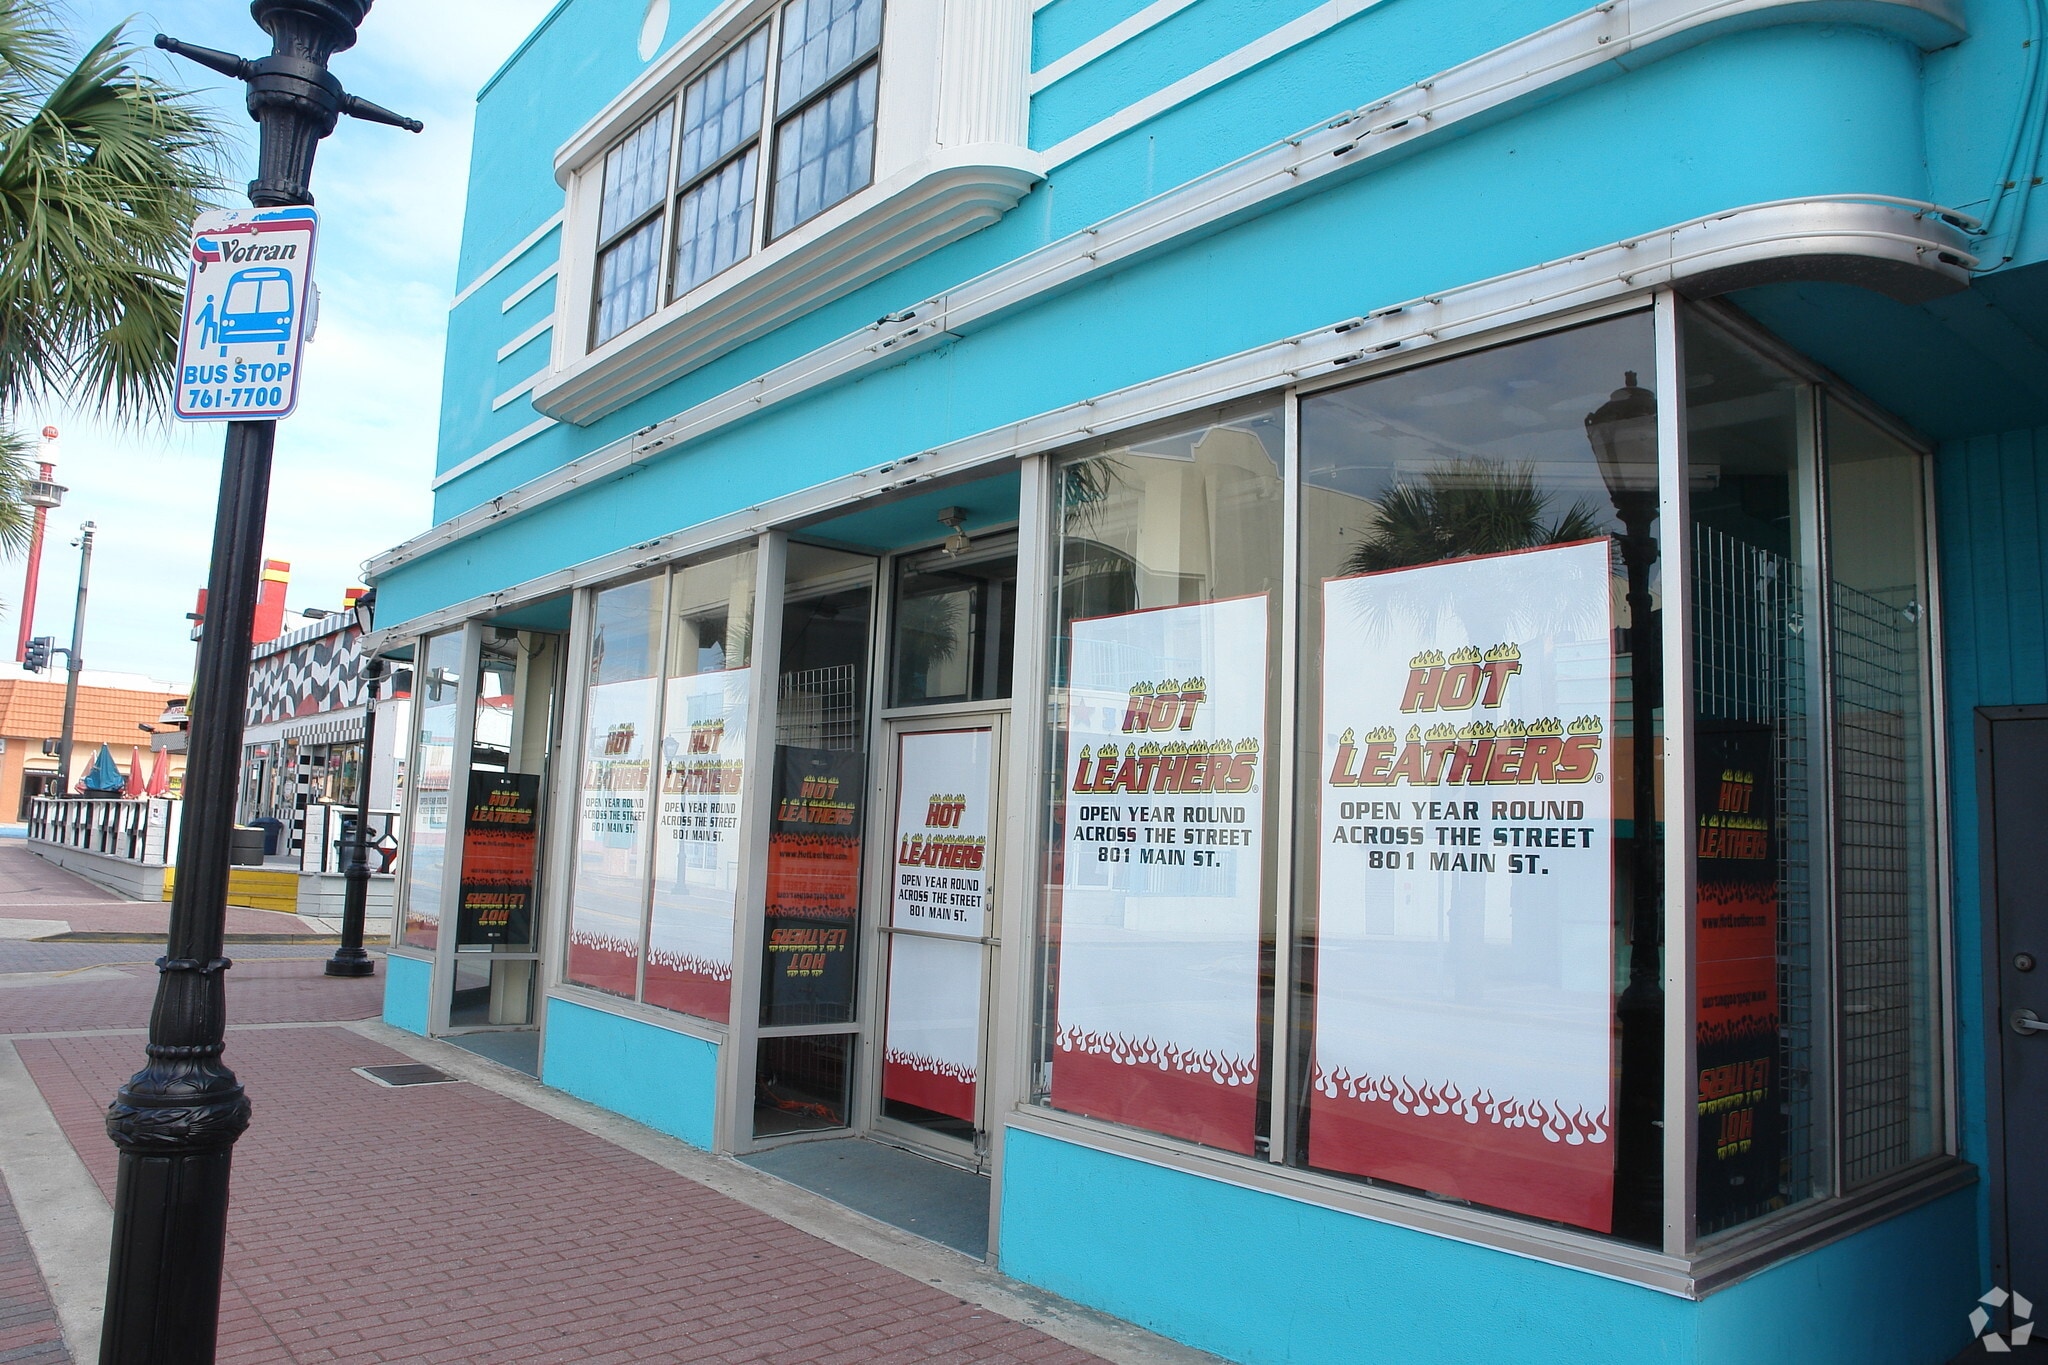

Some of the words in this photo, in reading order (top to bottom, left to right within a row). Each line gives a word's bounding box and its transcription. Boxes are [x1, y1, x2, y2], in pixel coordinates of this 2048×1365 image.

[222, 239, 297, 263] Votran
[184, 364, 228, 384] BUS
[234, 362, 292, 383] STOP
[189, 387, 282, 408] 761-7700
[1400, 660, 1522, 713] HOT
[1122, 692, 1207, 733] HOT
[605, 729, 635, 755] HOT
[687, 728, 724, 755] HOT
[584, 766, 649, 791] LEATHERS
[662, 767, 743, 795] LEATHERS
[1072, 754, 1258, 794] LEATHERS
[489, 794, 519, 807] HOT
[801, 782, 839, 800] HOT
[1719, 781, 1752, 813] HOT
[586, 798, 601, 808] OPEN
[605, 798, 620, 808] YEAR
[622, 798, 644, 809] ROUND
[664, 802, 685, 813] OPEN
[688, 802, 708, 813] YEAR
[711, 803, 736, 814] ROUND
[1340, 801, 1401, 820] OPEN
[1412, 801, 1479, 820] YEAR
[1491, 800, 1584, 820] ROUND
[472, 811, 531, 824] LEATHERS
[583, 810, 607, 820] ACROSS
[609, 811, 621, 820] THE
[622, 811, 646, 821] STREET
[661, 816, 691, 826] ACROSS
[694, 817, 707, 827] THE
[710, 817, 737, 828] STREET
[778, 804, 854, 825] LEATHERS
[925, 803, 966, 828] HOT
[1080, 806, 1121, 822] OPEN
[1128, 806, 1175, 822] YEAR
[1183, 806, 1245, 824] ROUND
[591, 822, 604, 832] 801
[607, 823, 623, 833] MAIN
[625, 824, 635, 834] ST.
[673, 829, 689, 840] 801
[692, 830, 710, 841] MAIN
[713, 831, 724, 842] ST.
[1074, 826, 1136, 842] ACROSS
[1145, 827, 1175, 844] THE
[1184, 828, 1252, 846] STREET
[1332, 826, 1424, 845] ACROSS
[1435, 827, 1481, 846] THE
[1493, 827, 1594, 848] STREET
[1698, 827, 1768, 860] LEATHERS
[898, 842, 985, 871] LEATHERS
[1098, 847, 1130, 863] 801
[1140, 848, 1185, 866] MAIN
[1193, 851, 1220, 867] ST.
[1369, 851, 1415, 870] 801
[1430, 853, 1496, 873] MAIN
[1508, 854, 1549, 875] ST.
[902, 874, 921, 886] OPEN
[925, 876, 947, 889] YEAR
[951, 878, 978, 891] ROUND
[465, 893, 526, 904] LEATHERS
[898, 889, 928, 902] ACROSS
[932, 891, 947, 904] THE
[950, 893, 981, 907] STREET
[479, 910, 509, 922] HOT
[910, 905, 925, 917] 801
[929, 907, 950, 920] MAIN
[954, 910, 967, 922] ST.
[769, 928, 847, 945] LEATHERS
[788, 953, 826, 970] HOT
[1699, 1056, 1770, 1100] LEATHERS
[1717, 1108, 1753, 1146] HOT
